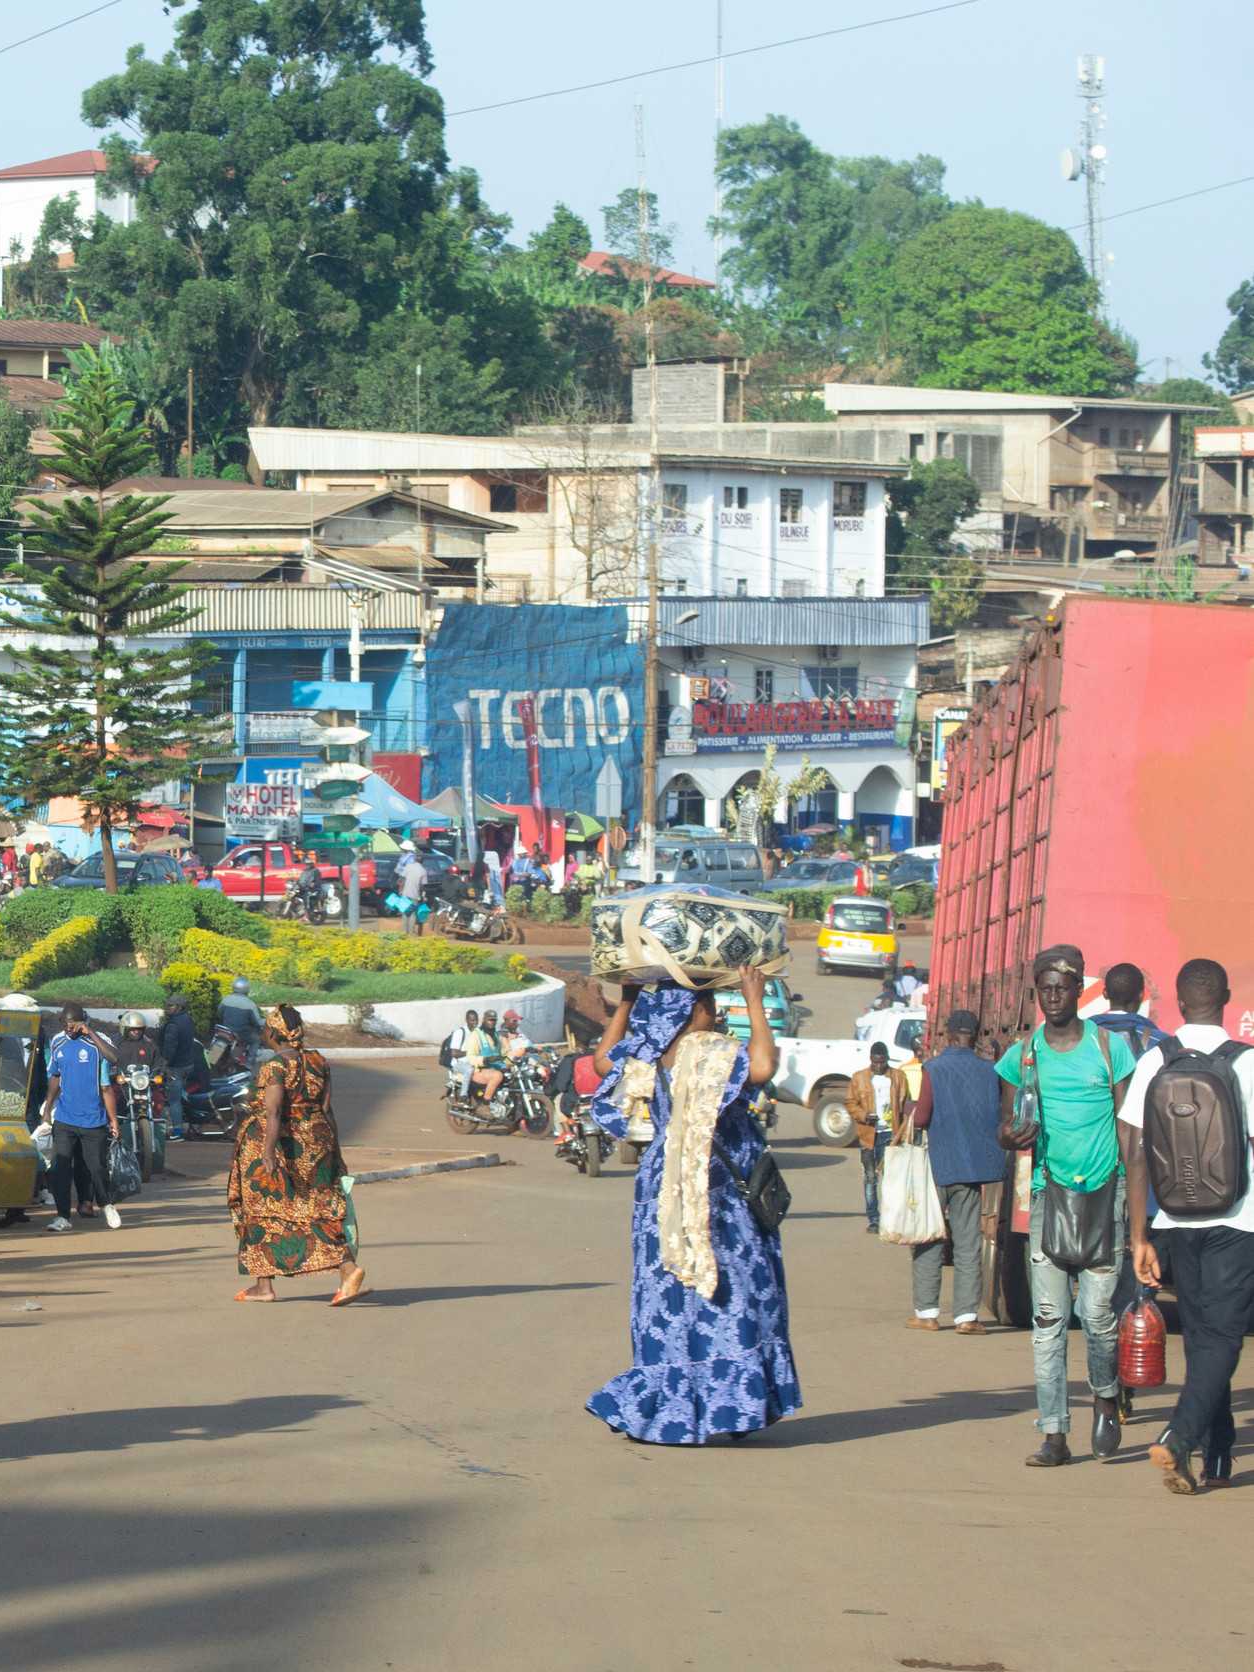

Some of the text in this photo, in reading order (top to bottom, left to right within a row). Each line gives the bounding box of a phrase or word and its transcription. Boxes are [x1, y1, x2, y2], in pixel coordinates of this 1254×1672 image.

[469, 686, 631, 750] TECNO
[697, 736, 739, 747] PATISSERIE
[747, 734, 803, 746] ALIMENTATION
[811, 733, 842, 743] GLACIER
[848, 730, 895, 741] RESTAURANT
[246, 785, 298, 805] HOTEL
[227, 804, 299, 817] MAJUNTA
